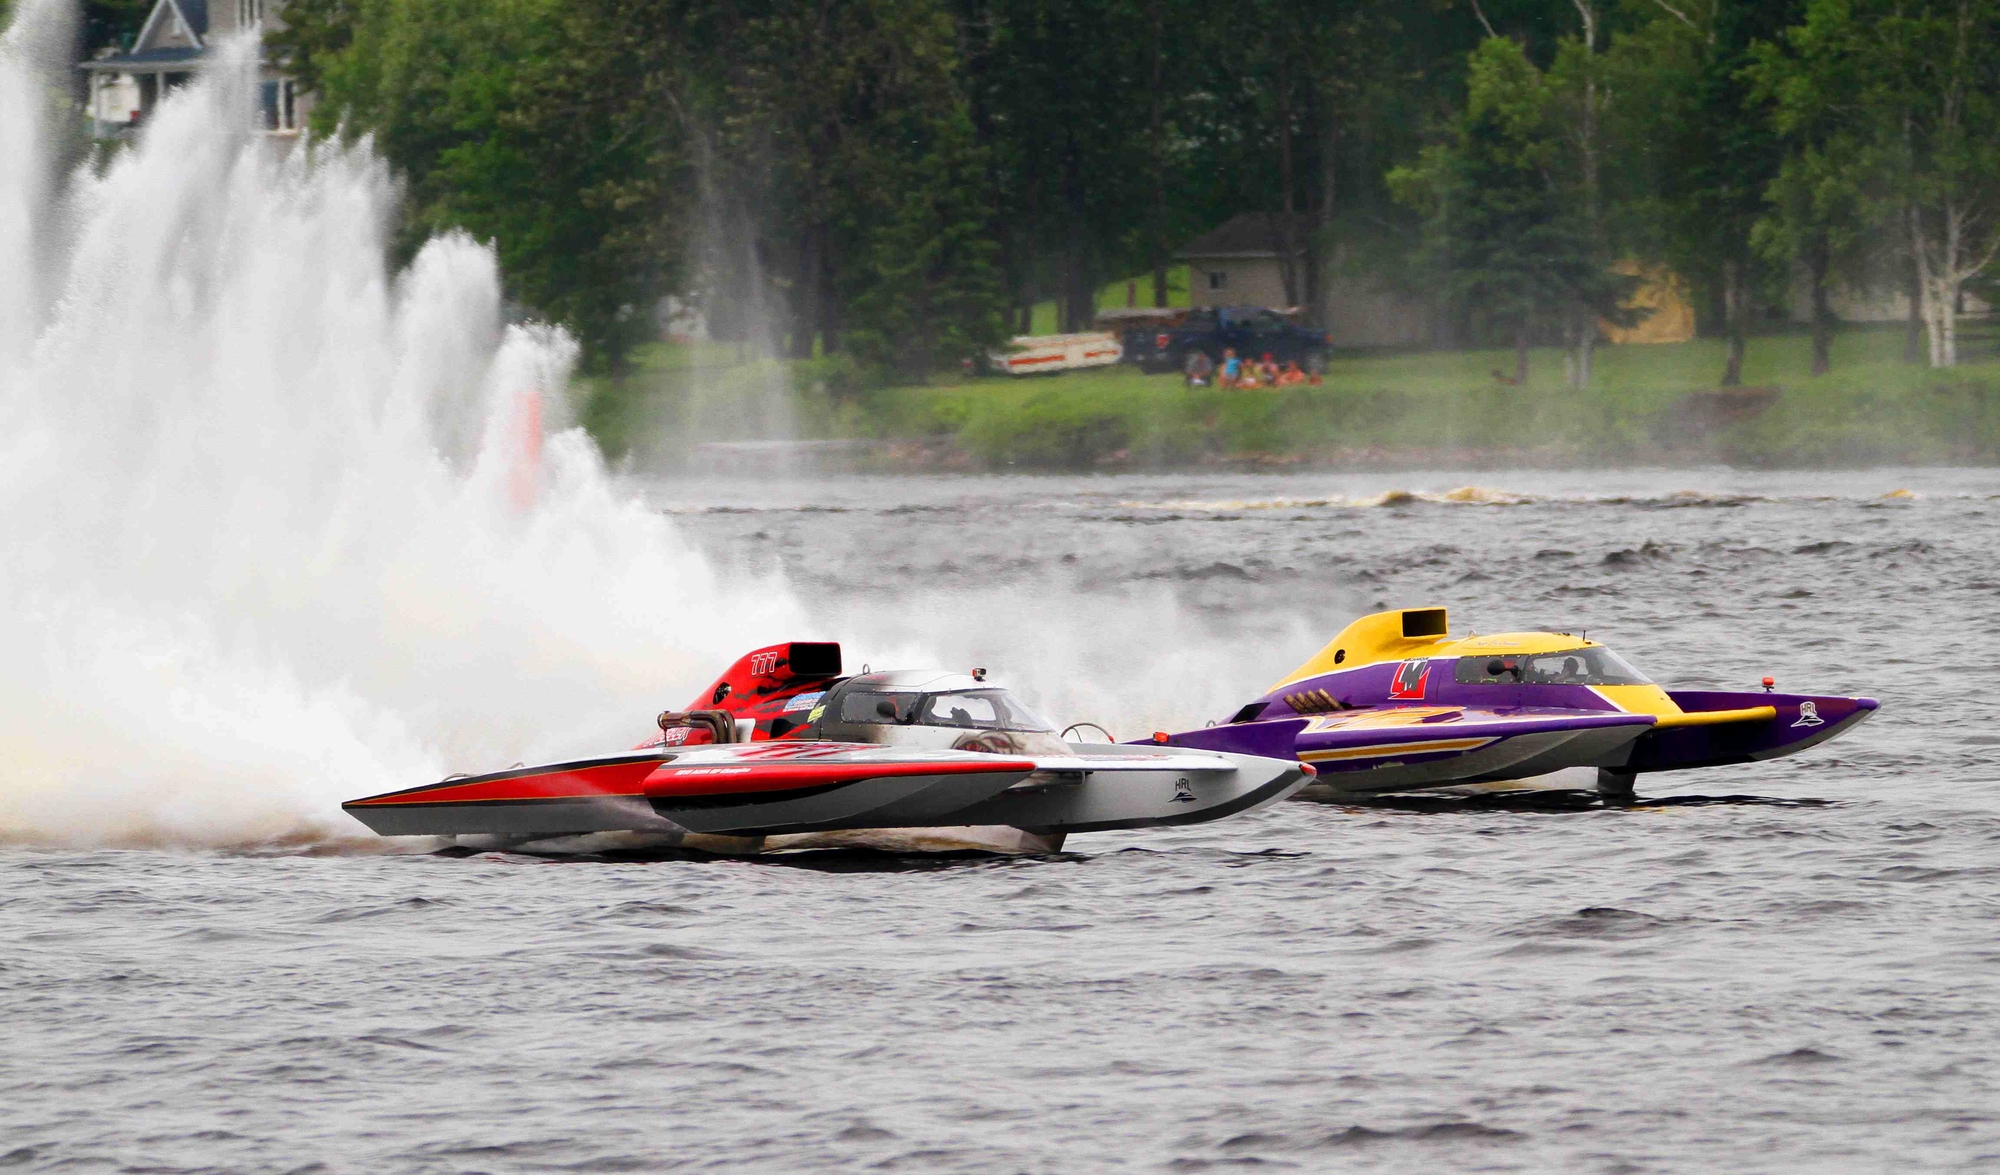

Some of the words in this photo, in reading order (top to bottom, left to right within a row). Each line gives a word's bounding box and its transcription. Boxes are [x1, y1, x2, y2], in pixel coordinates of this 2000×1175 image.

[751, 651, 778, 676] 777
[1801, 702, 1817, 714] HRL
[1175, 777, 1191, 792] HRL
